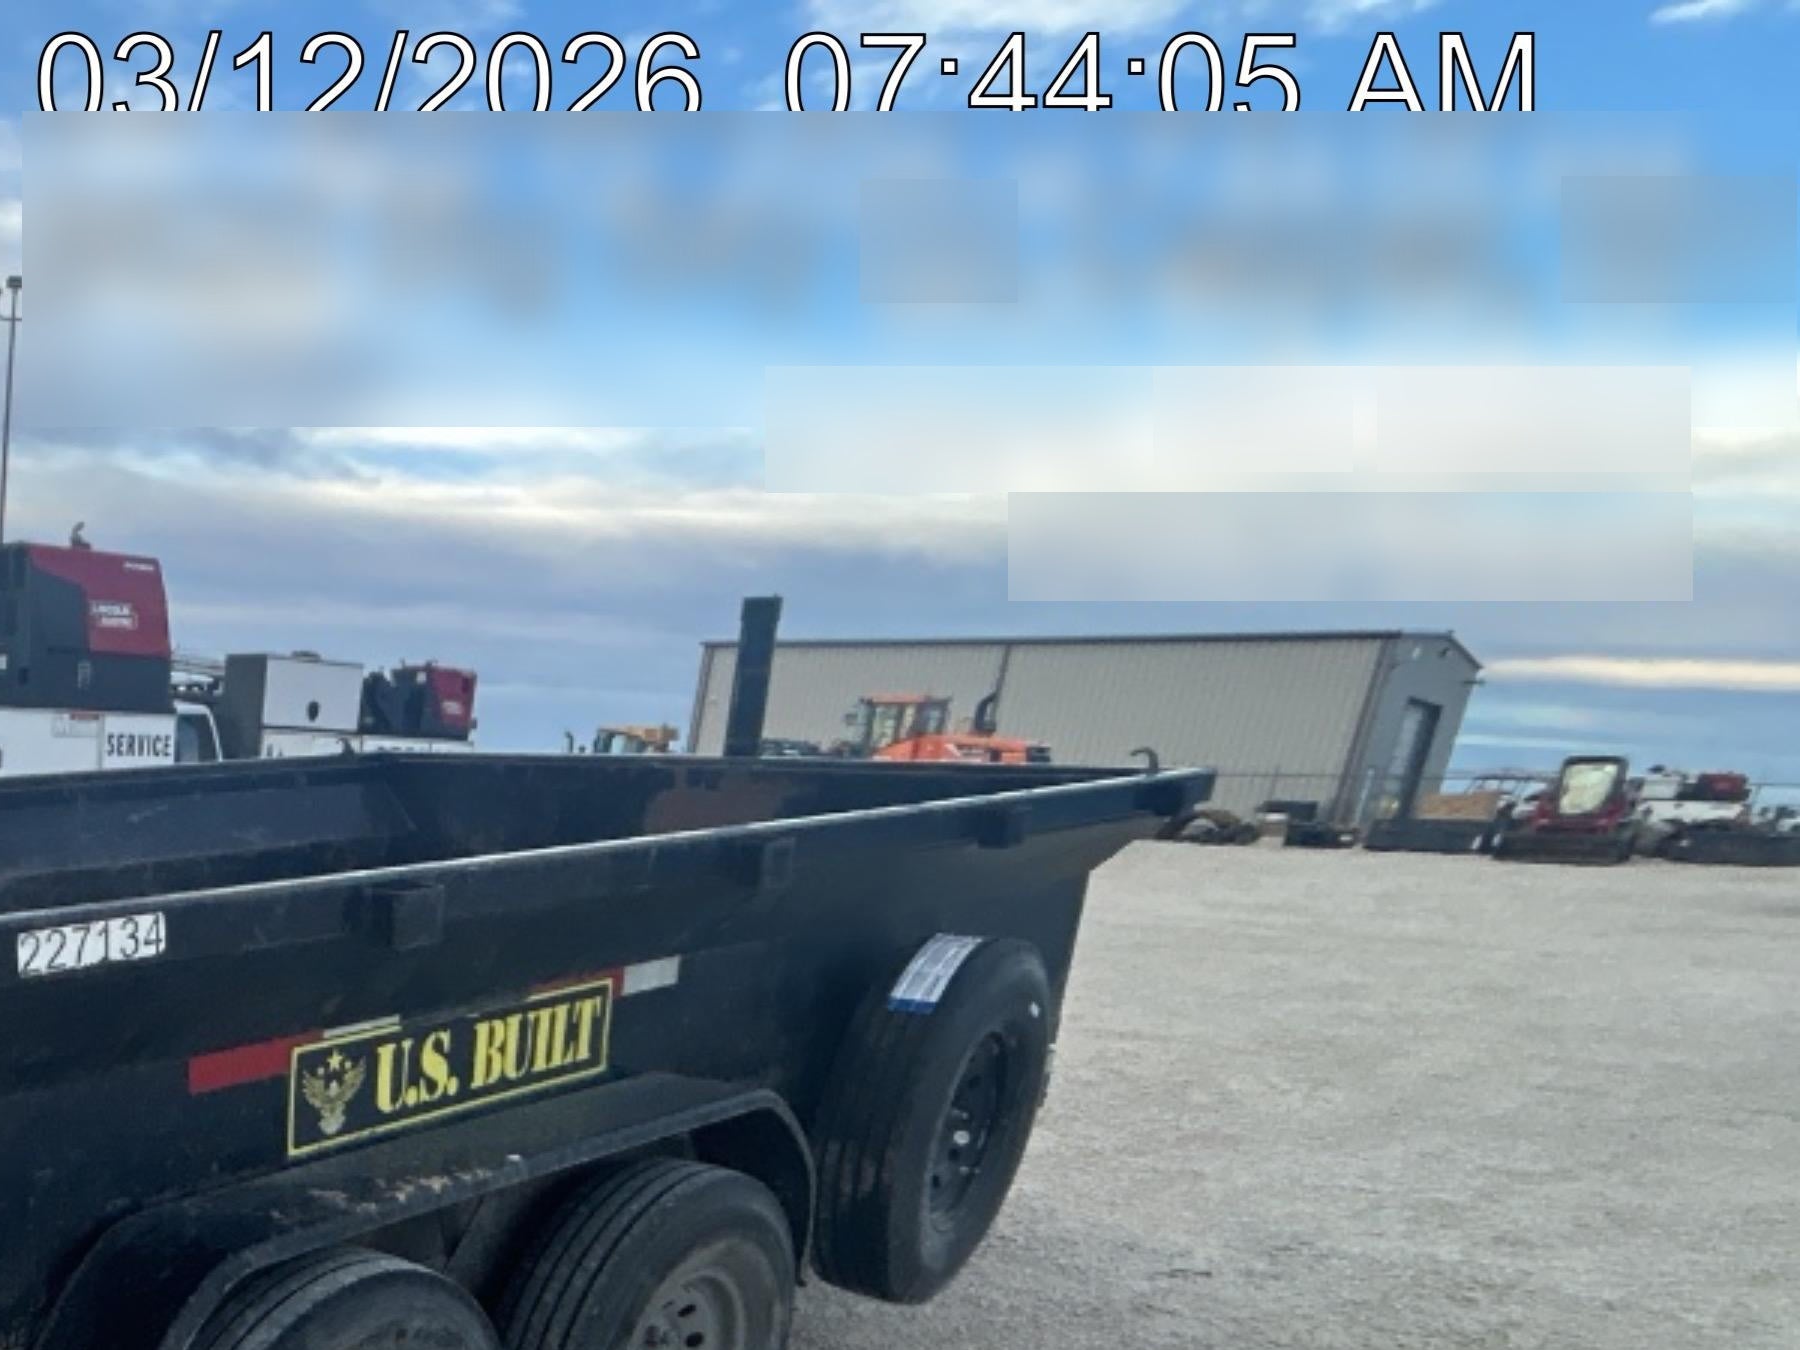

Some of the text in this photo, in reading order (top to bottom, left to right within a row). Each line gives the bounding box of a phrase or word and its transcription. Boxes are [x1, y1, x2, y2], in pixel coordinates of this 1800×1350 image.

[107, 733, 172, 757] SERVICE
[19, 912, 164, 975] 227134
[375, 995, 602, 1115] U.S. BUILT
